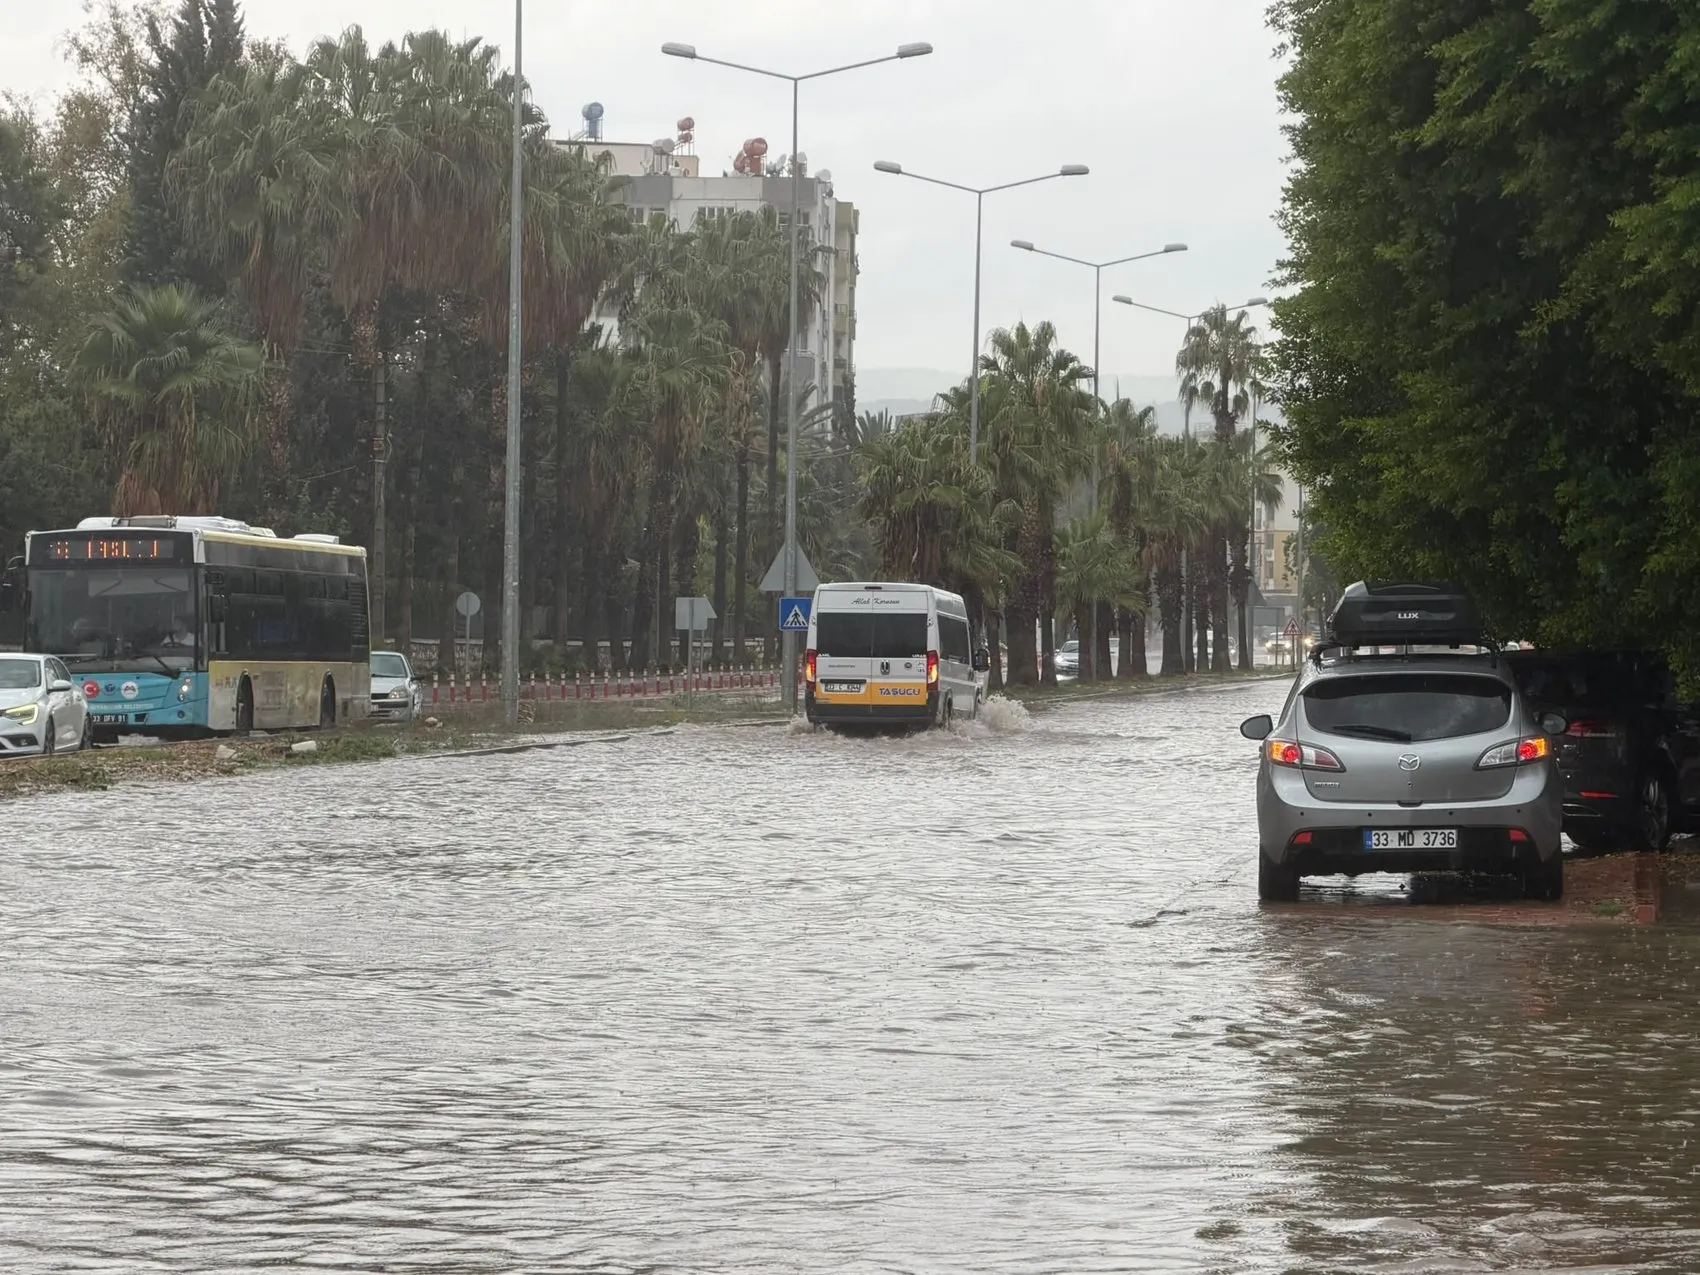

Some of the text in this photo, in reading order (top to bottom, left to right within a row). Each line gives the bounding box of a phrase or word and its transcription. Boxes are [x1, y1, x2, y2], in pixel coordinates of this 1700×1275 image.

[1373, 831, 1455, 847] 33 MD 3736
